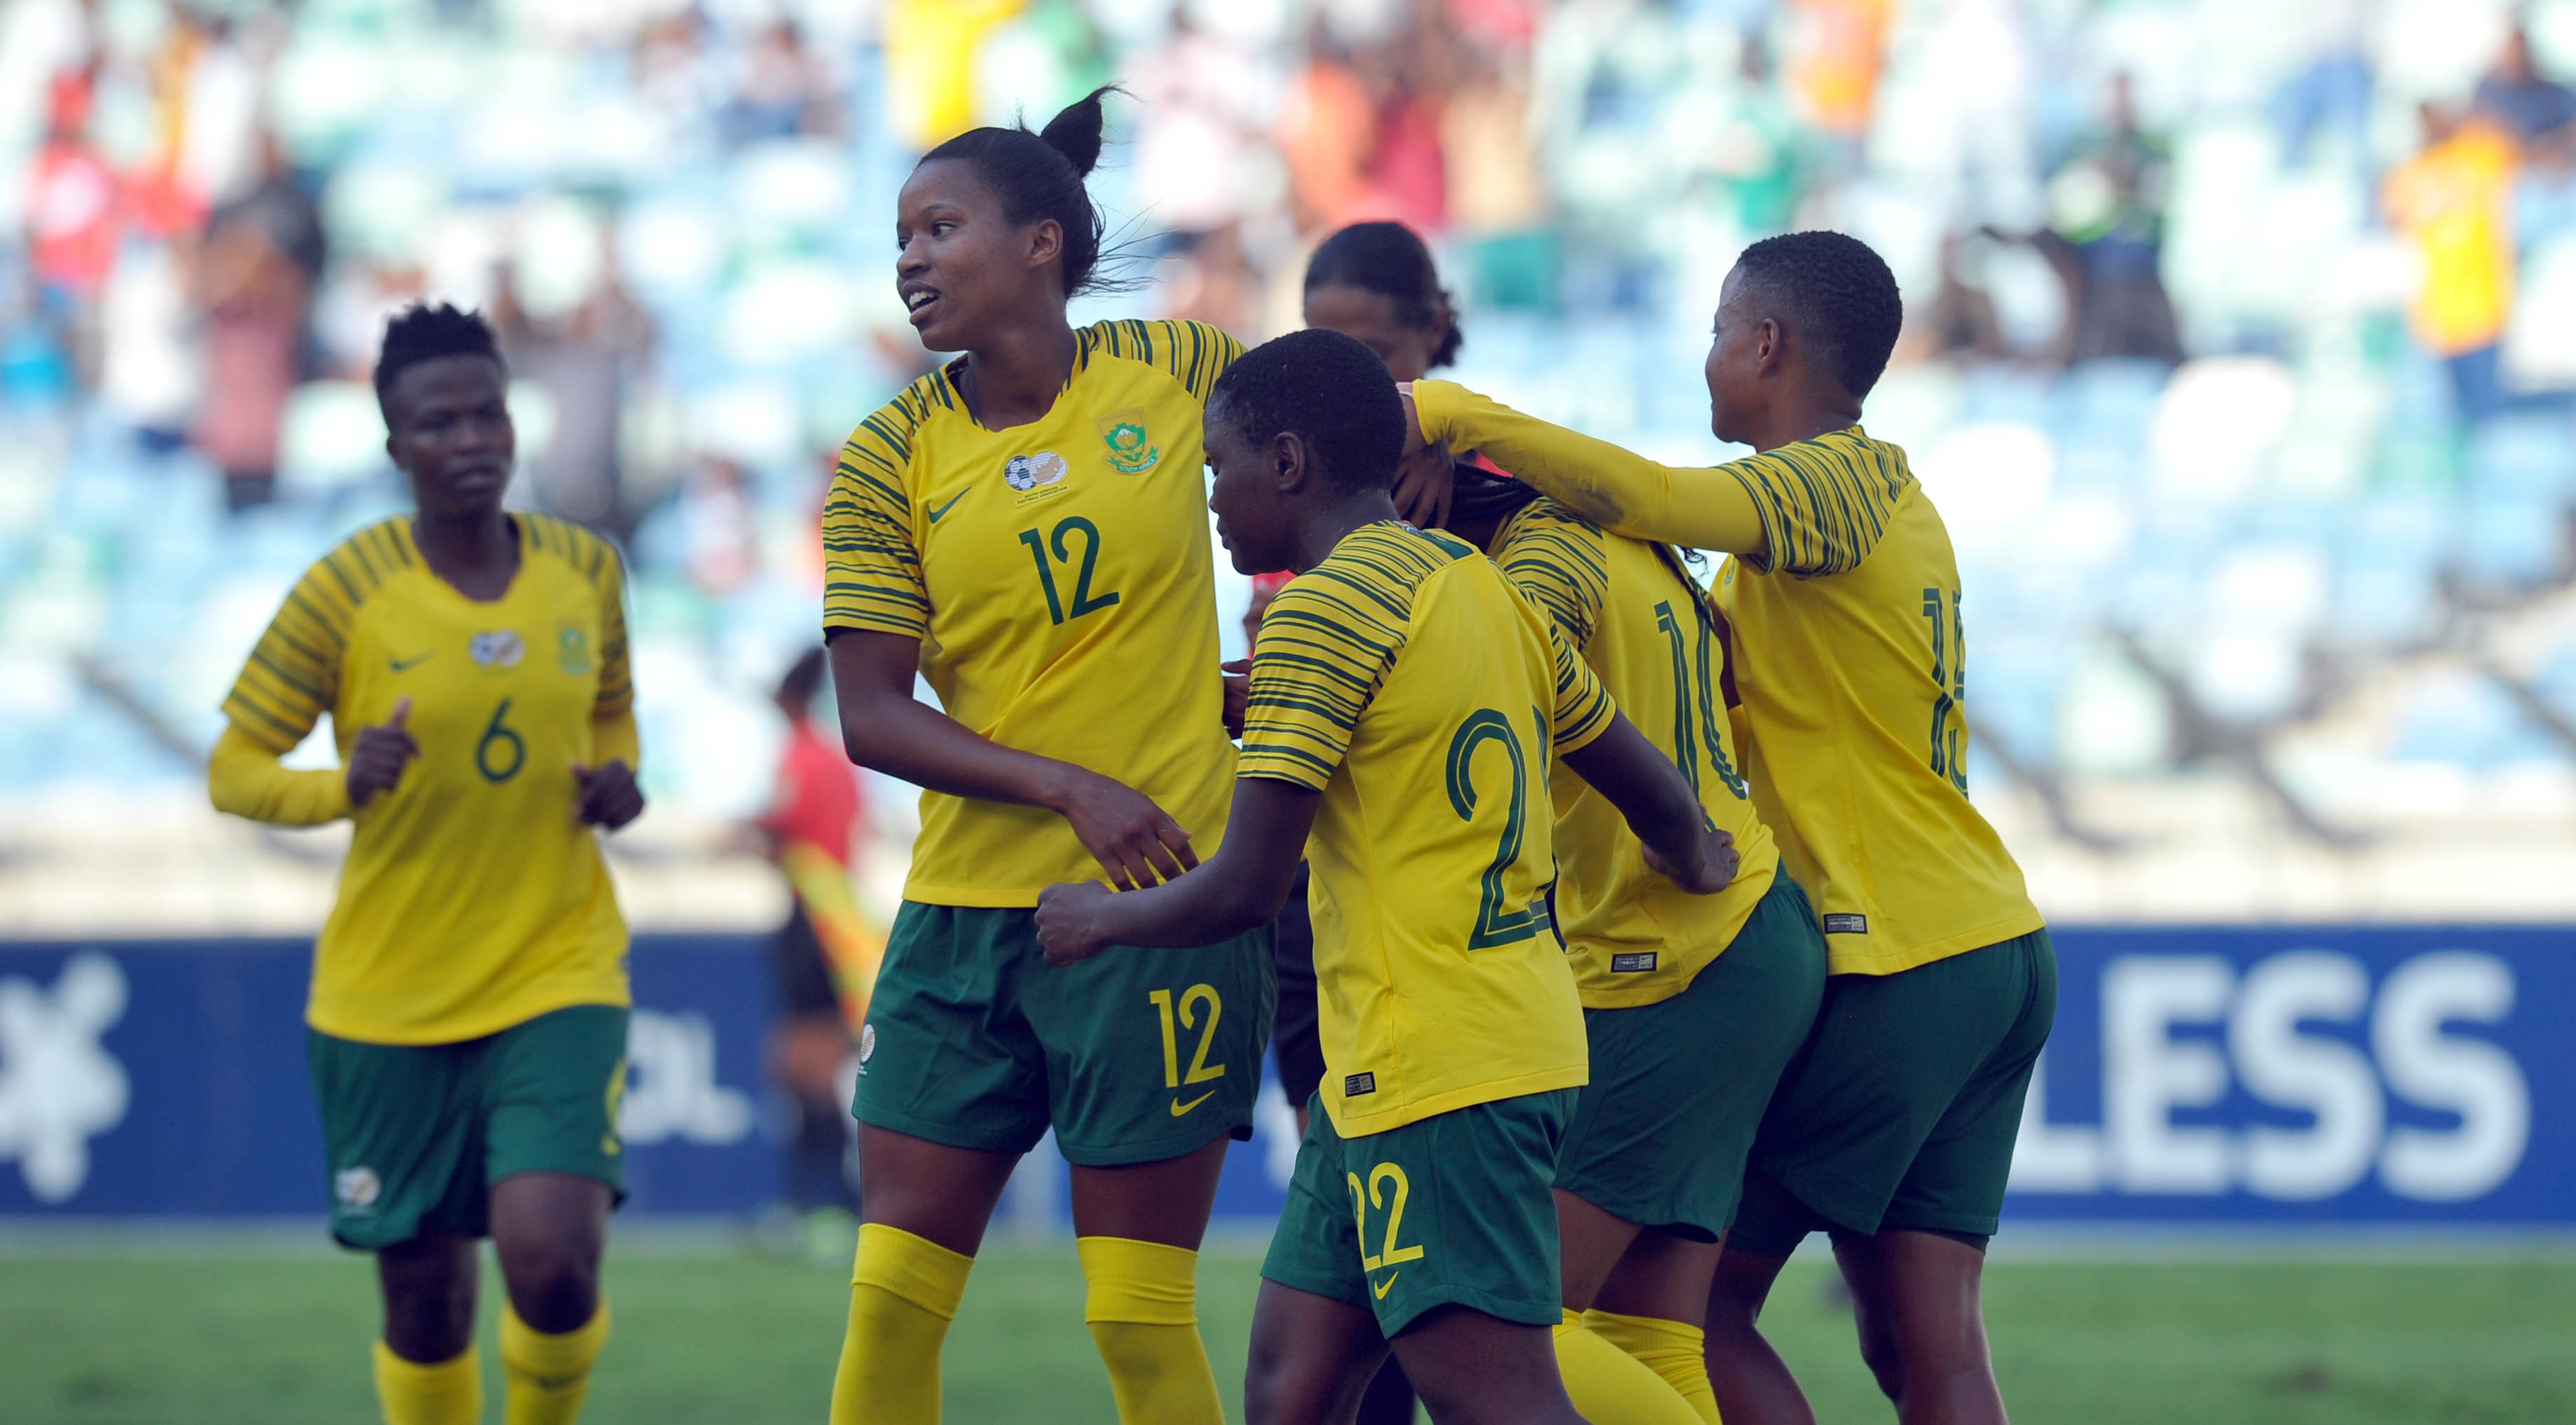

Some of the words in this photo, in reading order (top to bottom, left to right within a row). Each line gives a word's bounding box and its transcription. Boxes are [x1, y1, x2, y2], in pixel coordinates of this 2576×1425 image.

[1018, 516, 1120, 626] 12
[477, 696, 526, 784] 6
[1149, 983, 1226, 1088] 12
[1347, 1162, 1424, 1273] 22
